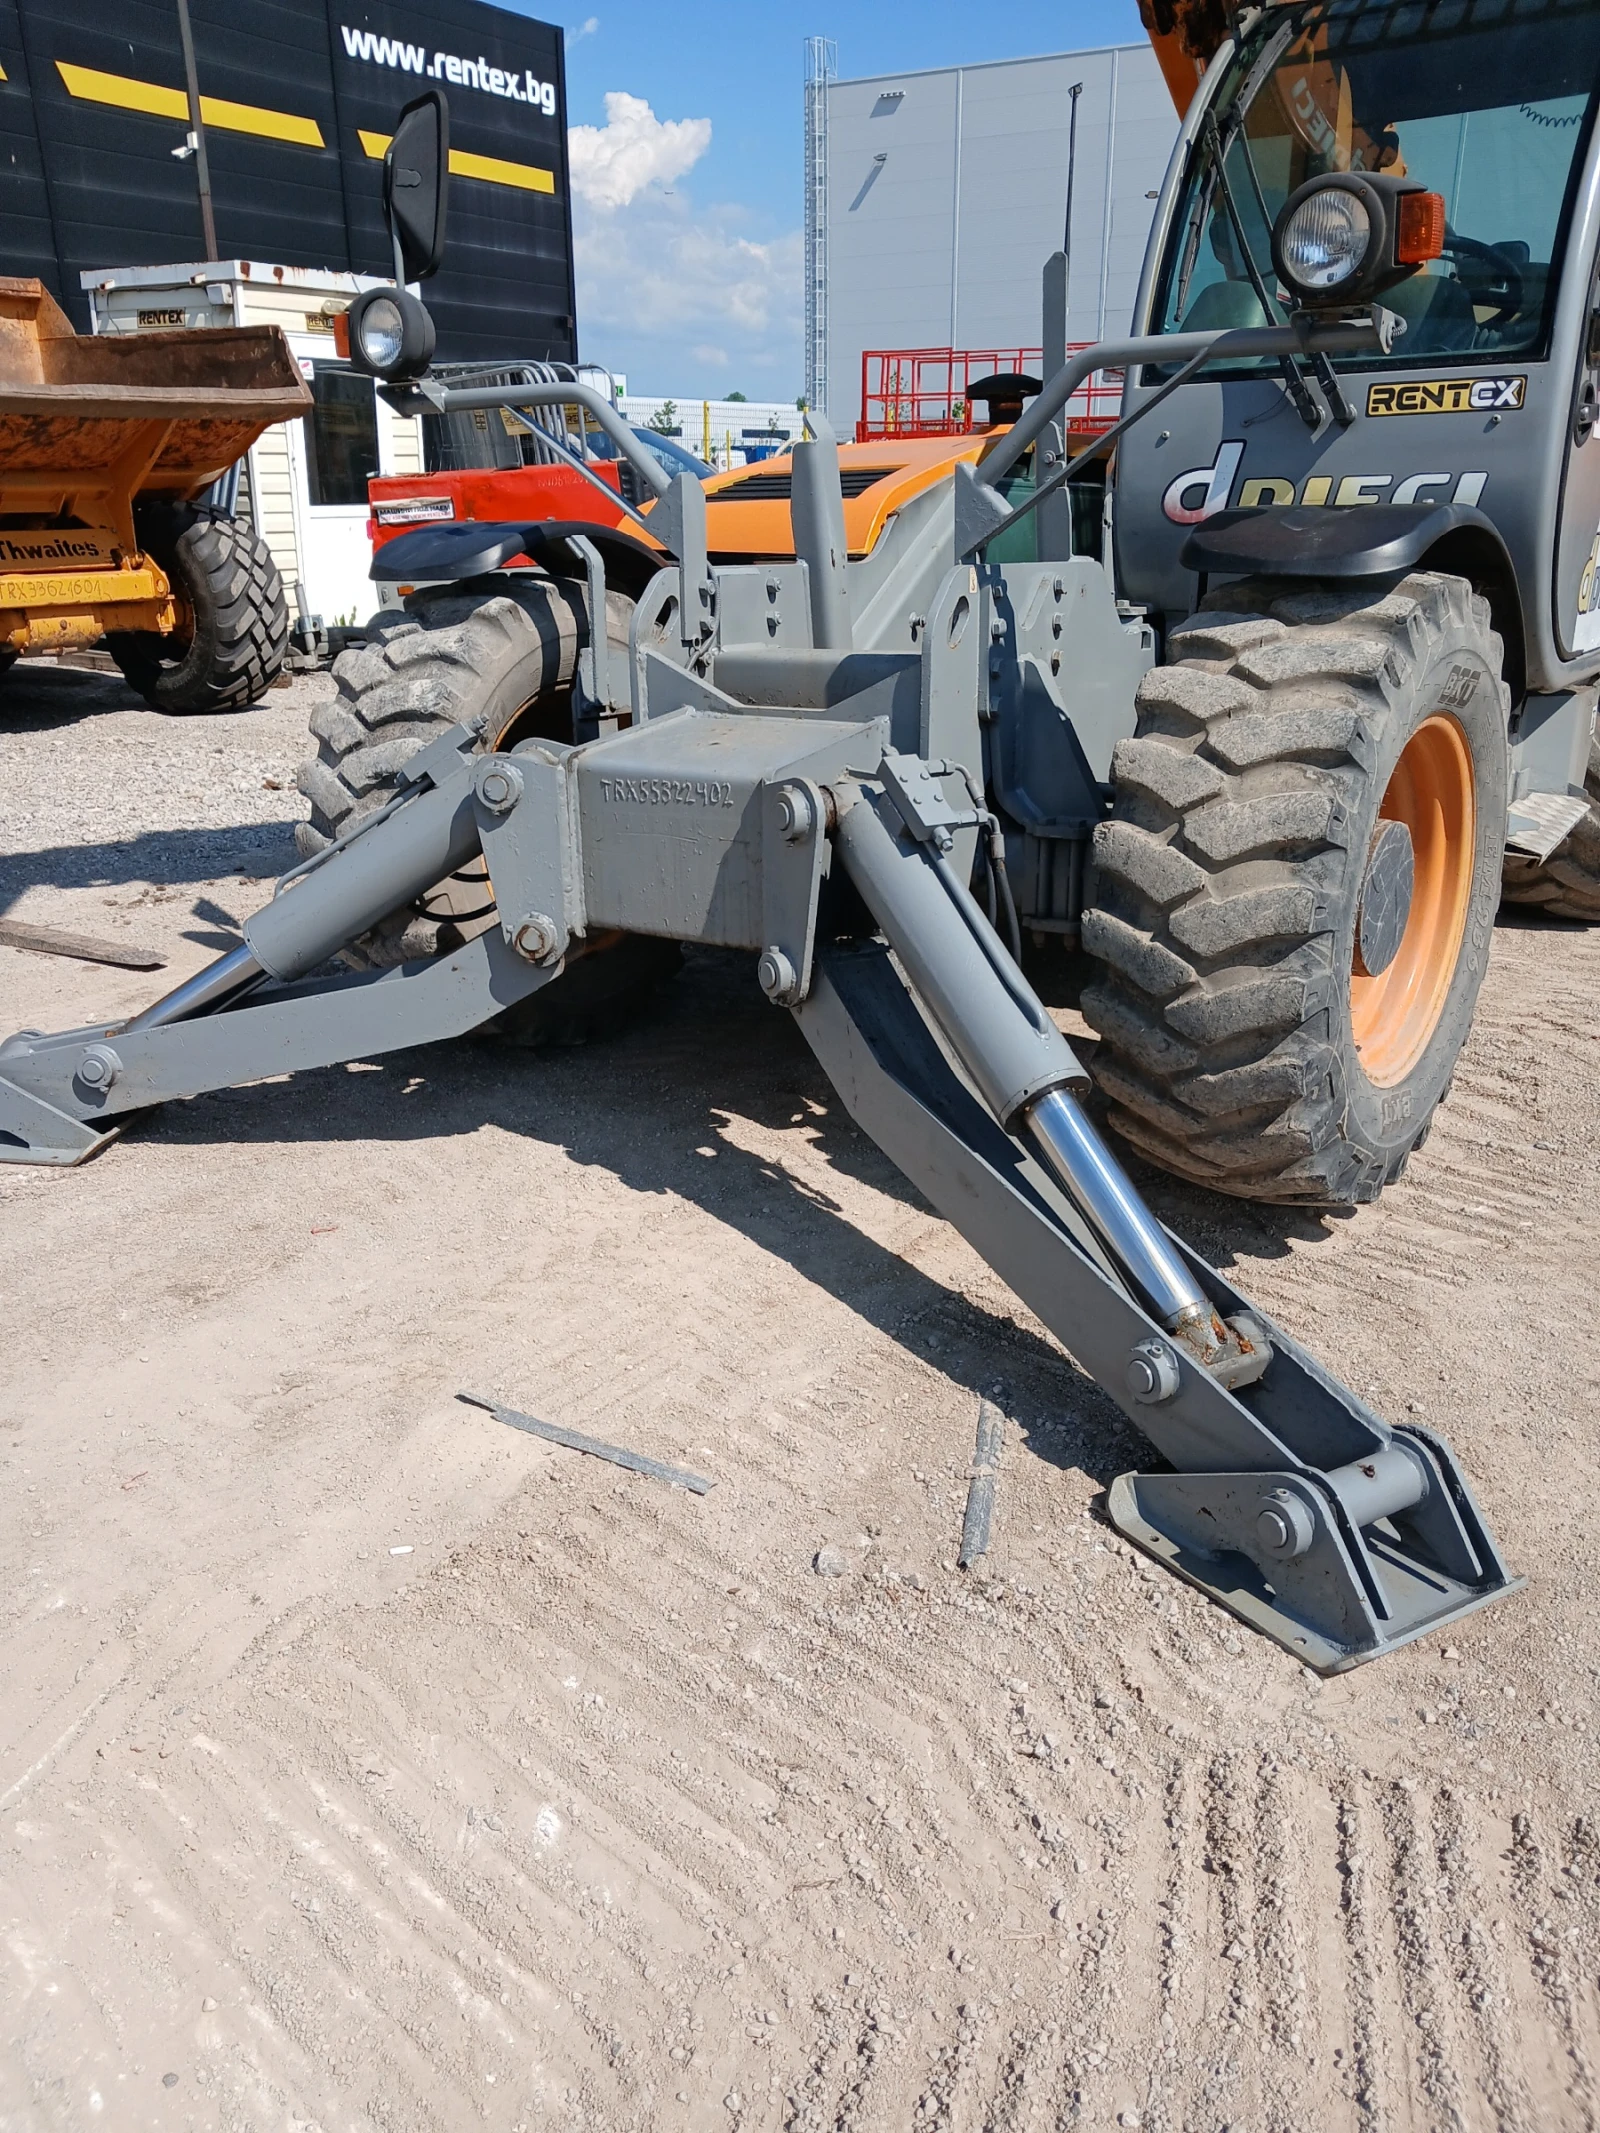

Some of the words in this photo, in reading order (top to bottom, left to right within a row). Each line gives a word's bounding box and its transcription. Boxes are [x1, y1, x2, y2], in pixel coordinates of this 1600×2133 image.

[340, 25, 556, 116] www.rentex.bg
[138, 309, 184, 325] RENTEX
[308, 315, 335, 328] RENTE
[1370, 378, 1522, 413] RENTEX
[0, 539, 99, 560] Thwaites
[1440, 668, 1479, 704] BKT
[600, 778, 735, 806] TRX55322402
